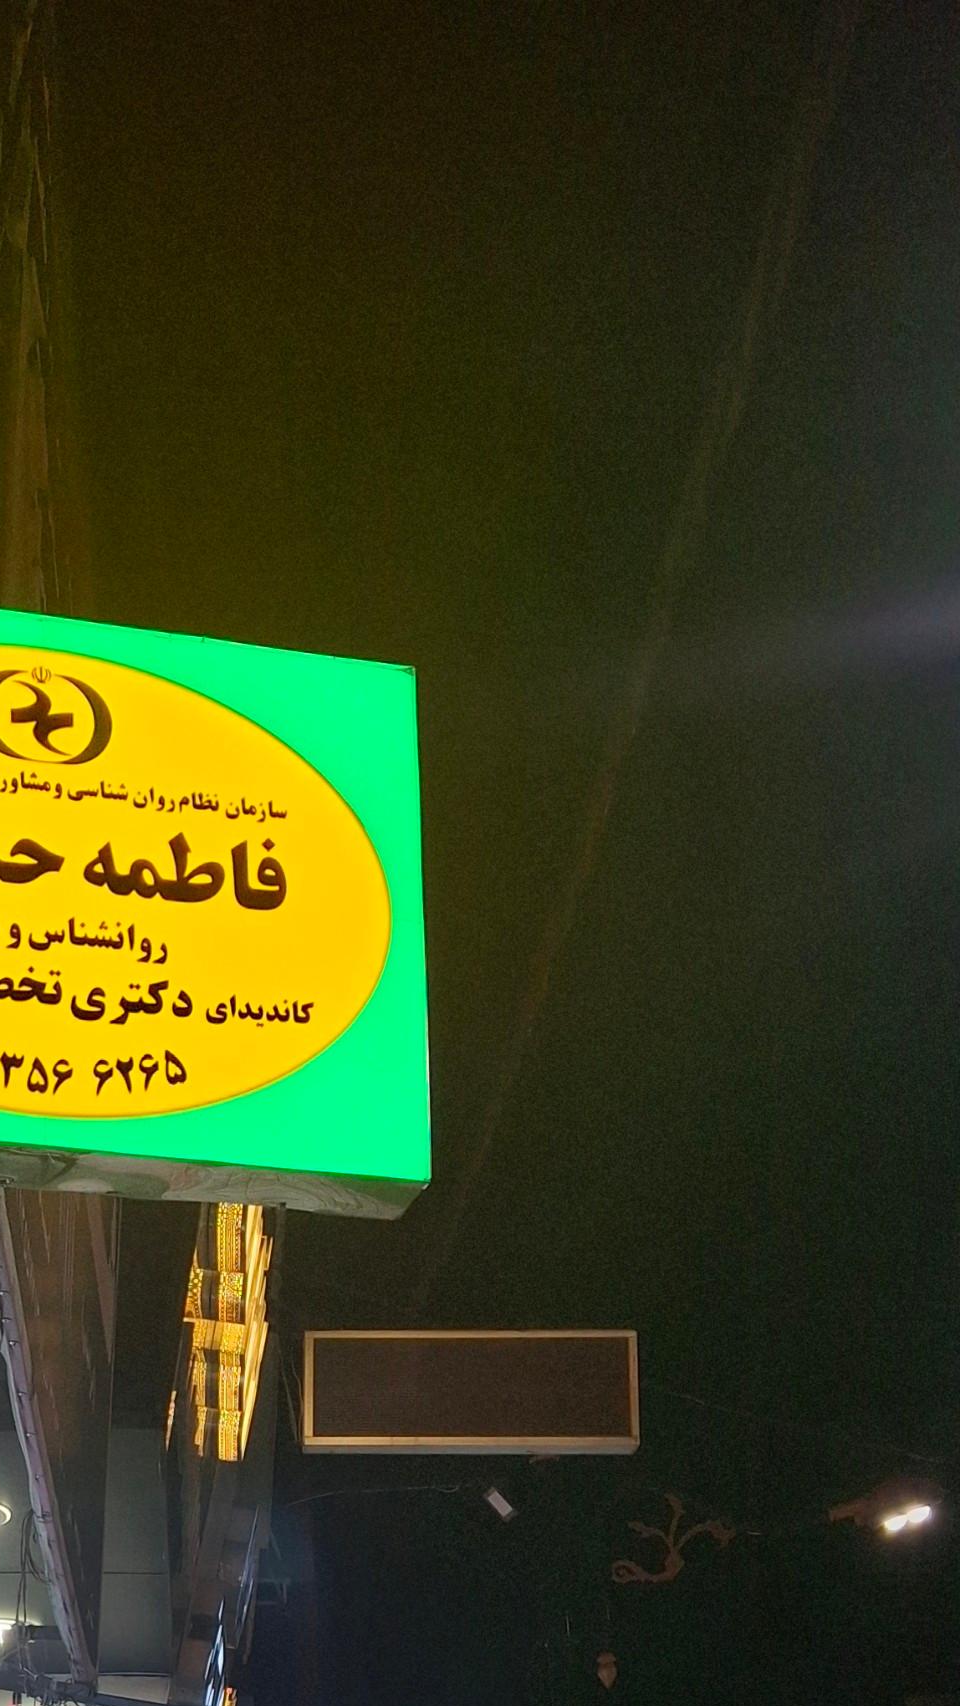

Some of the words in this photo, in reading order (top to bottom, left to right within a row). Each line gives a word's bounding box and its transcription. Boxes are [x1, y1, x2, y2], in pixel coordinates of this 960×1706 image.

[178, 791, 220, 813] نظام
[225, 797, 288, 823] سازمان
[82, 832, 288, 911] فاطمه
[6, 922, 22, 950] و
[28, 917, 168, 965] روانشناس
[70, 980, 194, 1026] دکتری
[205, 994, 314, 1028] کاندیدای
[0, 1051, 74, 1095] ۳۵۶
